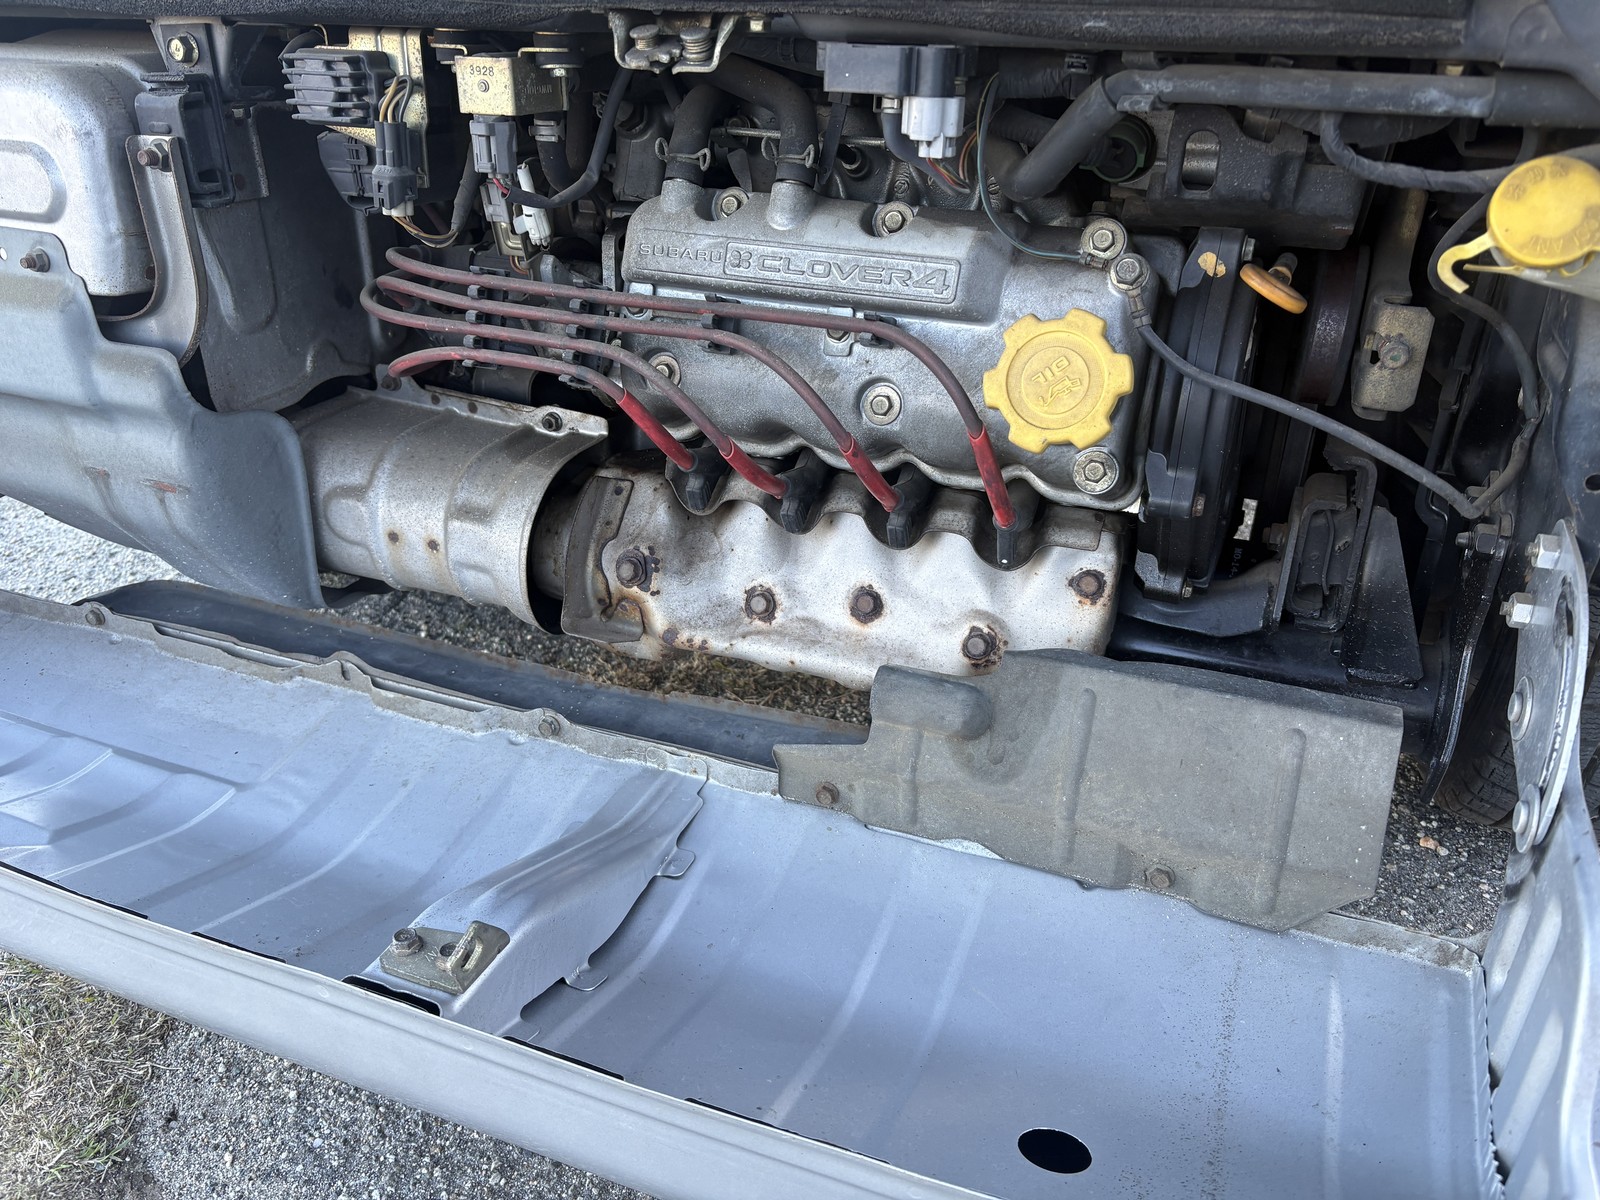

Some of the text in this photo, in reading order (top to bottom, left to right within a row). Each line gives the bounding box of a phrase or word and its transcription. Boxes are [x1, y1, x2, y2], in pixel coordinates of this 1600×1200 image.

[469, 65, 495, 77] 3928
[638, 243, 722, 263] SUBARU
[1031, 355, 1071, 384] OIL
